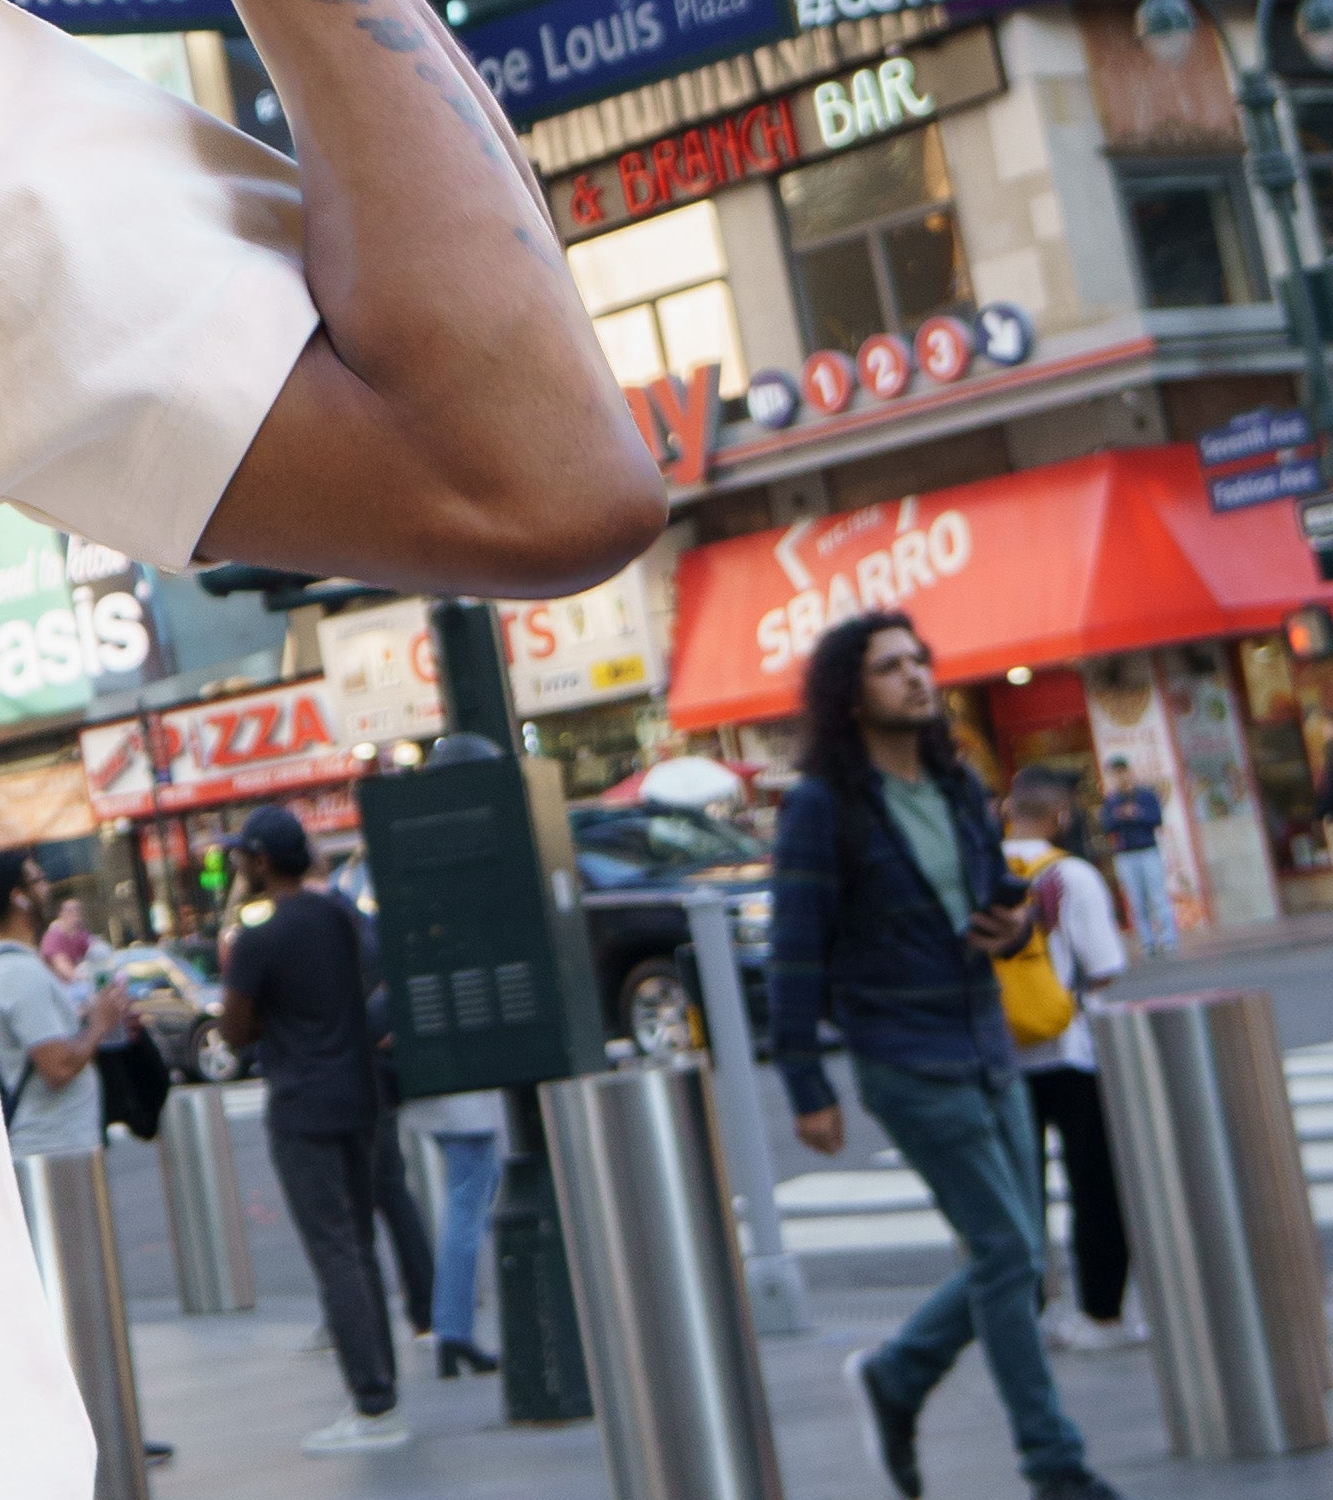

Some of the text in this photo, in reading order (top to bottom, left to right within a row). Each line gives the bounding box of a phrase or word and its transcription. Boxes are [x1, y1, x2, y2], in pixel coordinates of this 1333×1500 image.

[538, 0, 666, 84] Louis
[568, 184, 605, 227] &
[617, 98, 801, 217] BRANCH
[813, 54, 936, 149] BAR
[814, 367, 839, 403] 1
[867, 346, 897, 390] 2
[927, 330, 954, 372] 3
[757, 509, 971, 675] SBARRO
[151, 695, 332, 772] PIZZA
